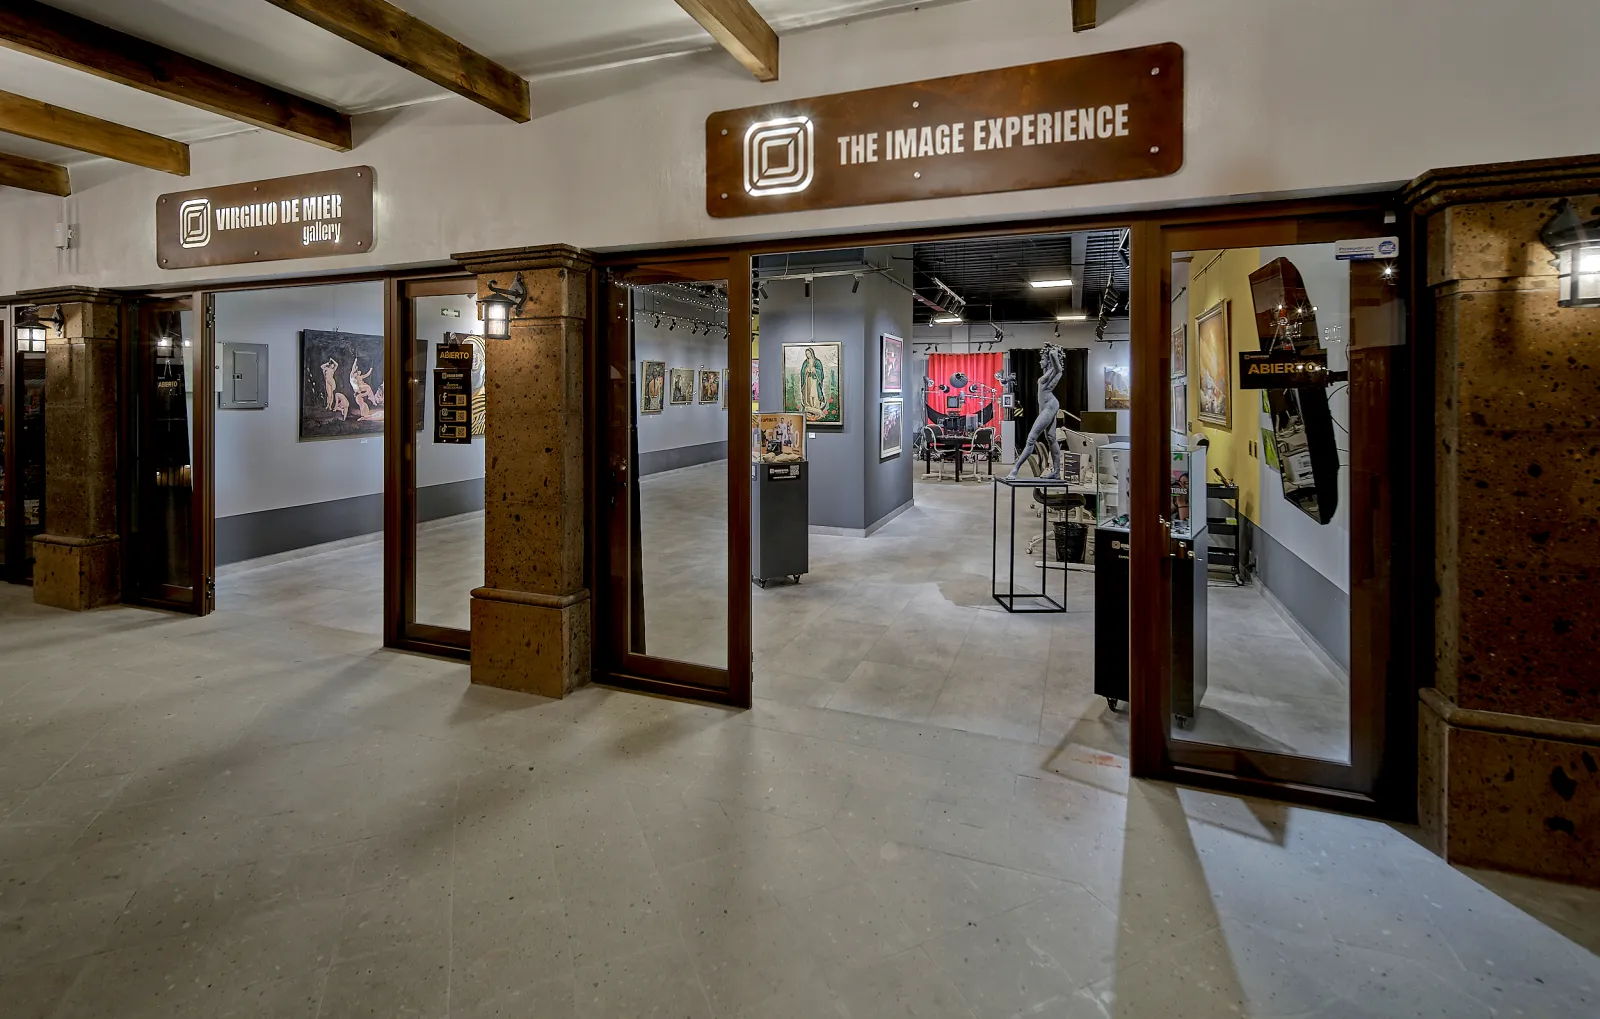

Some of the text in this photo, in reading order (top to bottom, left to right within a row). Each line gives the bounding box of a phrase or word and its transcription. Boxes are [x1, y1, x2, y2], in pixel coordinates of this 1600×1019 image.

[837, 103, 1130, 165] THE IMAGE EXPERIENCE
[215, 194, 342, 231] VIRGILIO DE MIER
[302, 221, 342, 246] gallery
[440, 351, 470, 360] ABIERTO
[1248, 361, 1318, 375] ABIERTO
